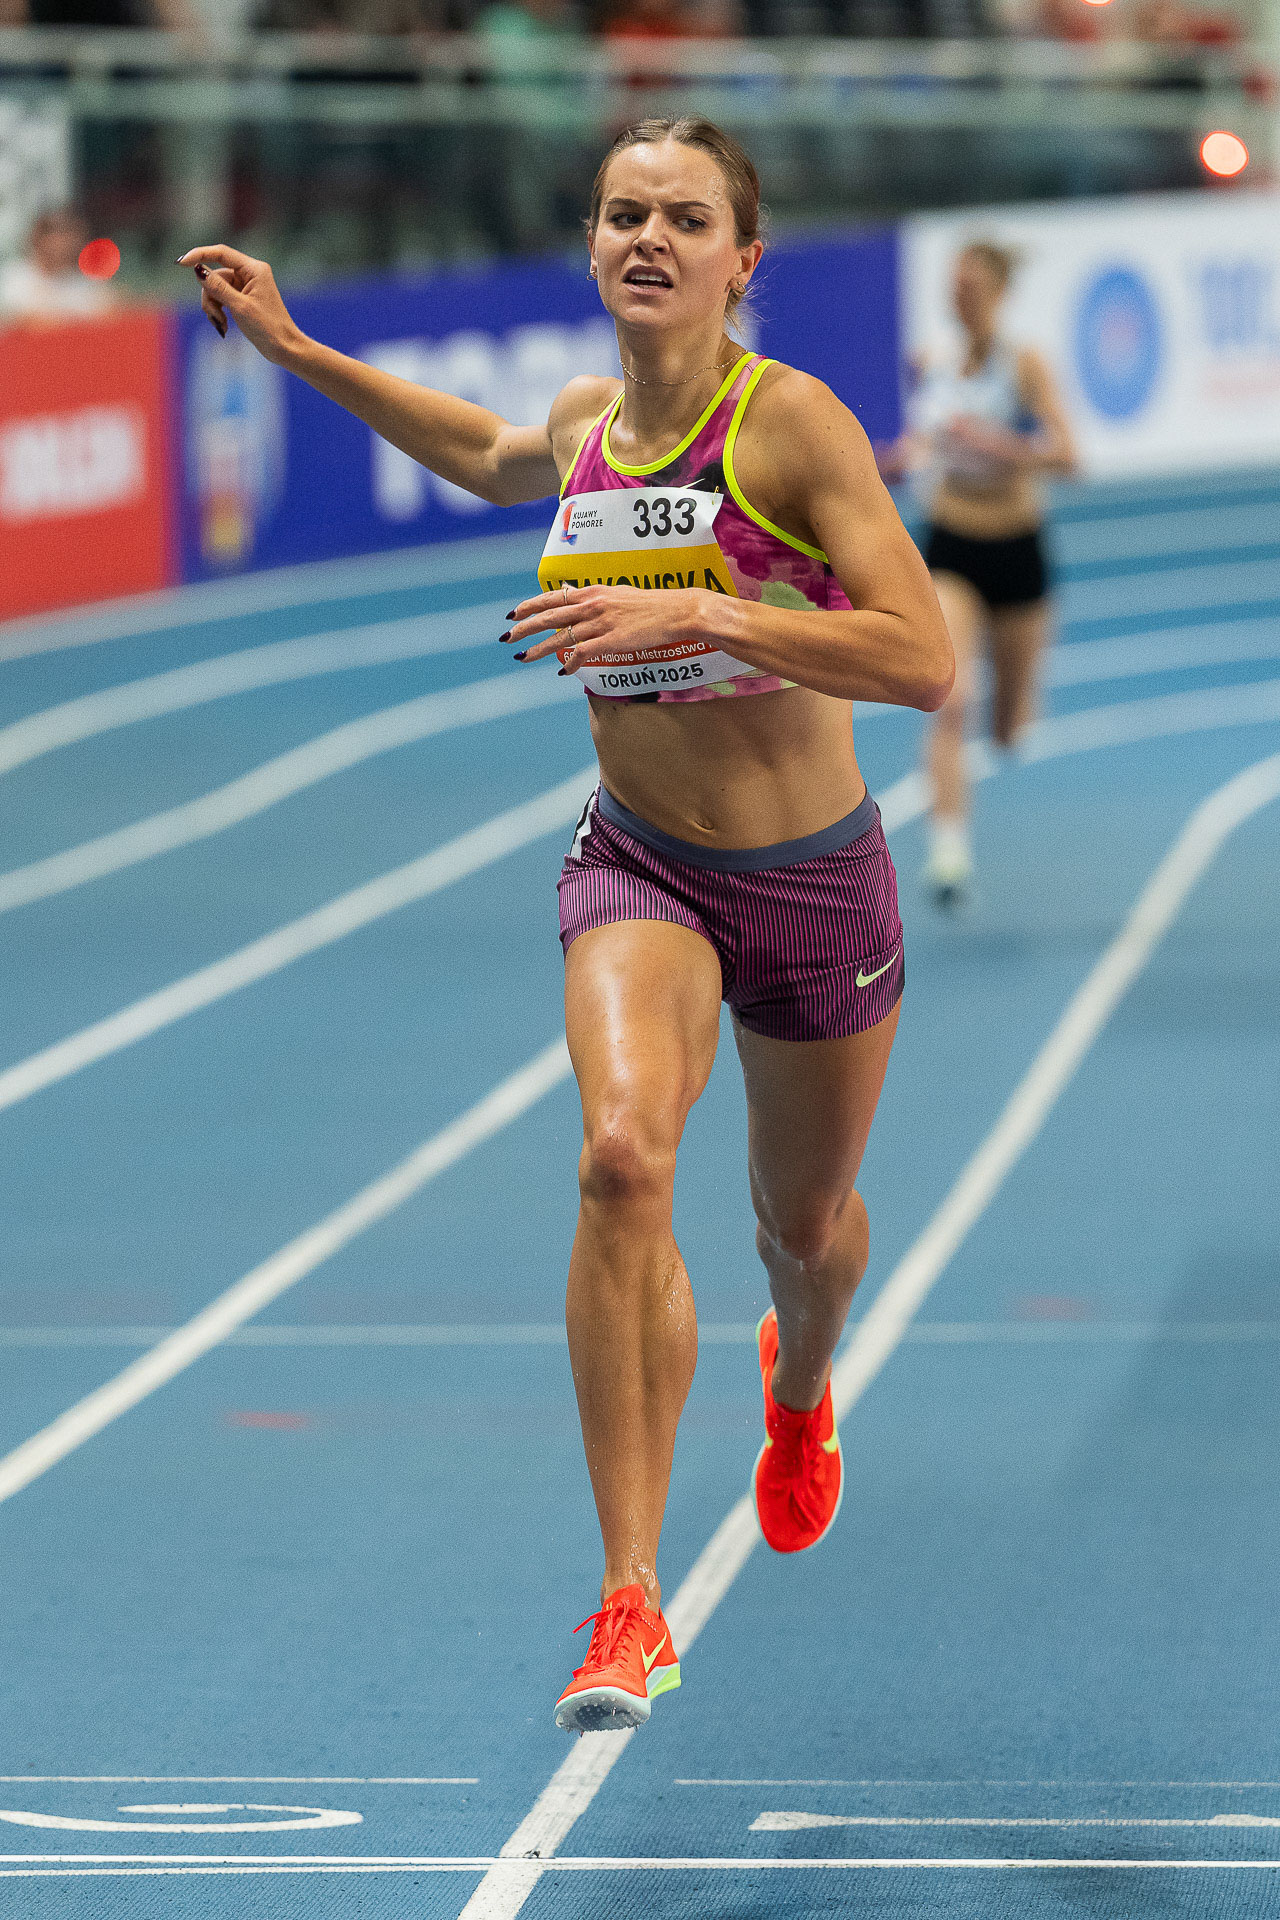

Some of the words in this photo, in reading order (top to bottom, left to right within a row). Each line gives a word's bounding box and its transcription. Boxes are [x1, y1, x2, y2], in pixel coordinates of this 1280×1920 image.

[571, 519, 604, 529] POMORZE
[572, 510, 598, 520] KUJAWY
[632, 497, 698, 538] 333
[601, 652, 634, 663] Halowe
[635, 641, 706, 661] Mistrzostwa
[598, 667, 657, 689] TORUŃ
[657, 663, 705, 683] 2025
